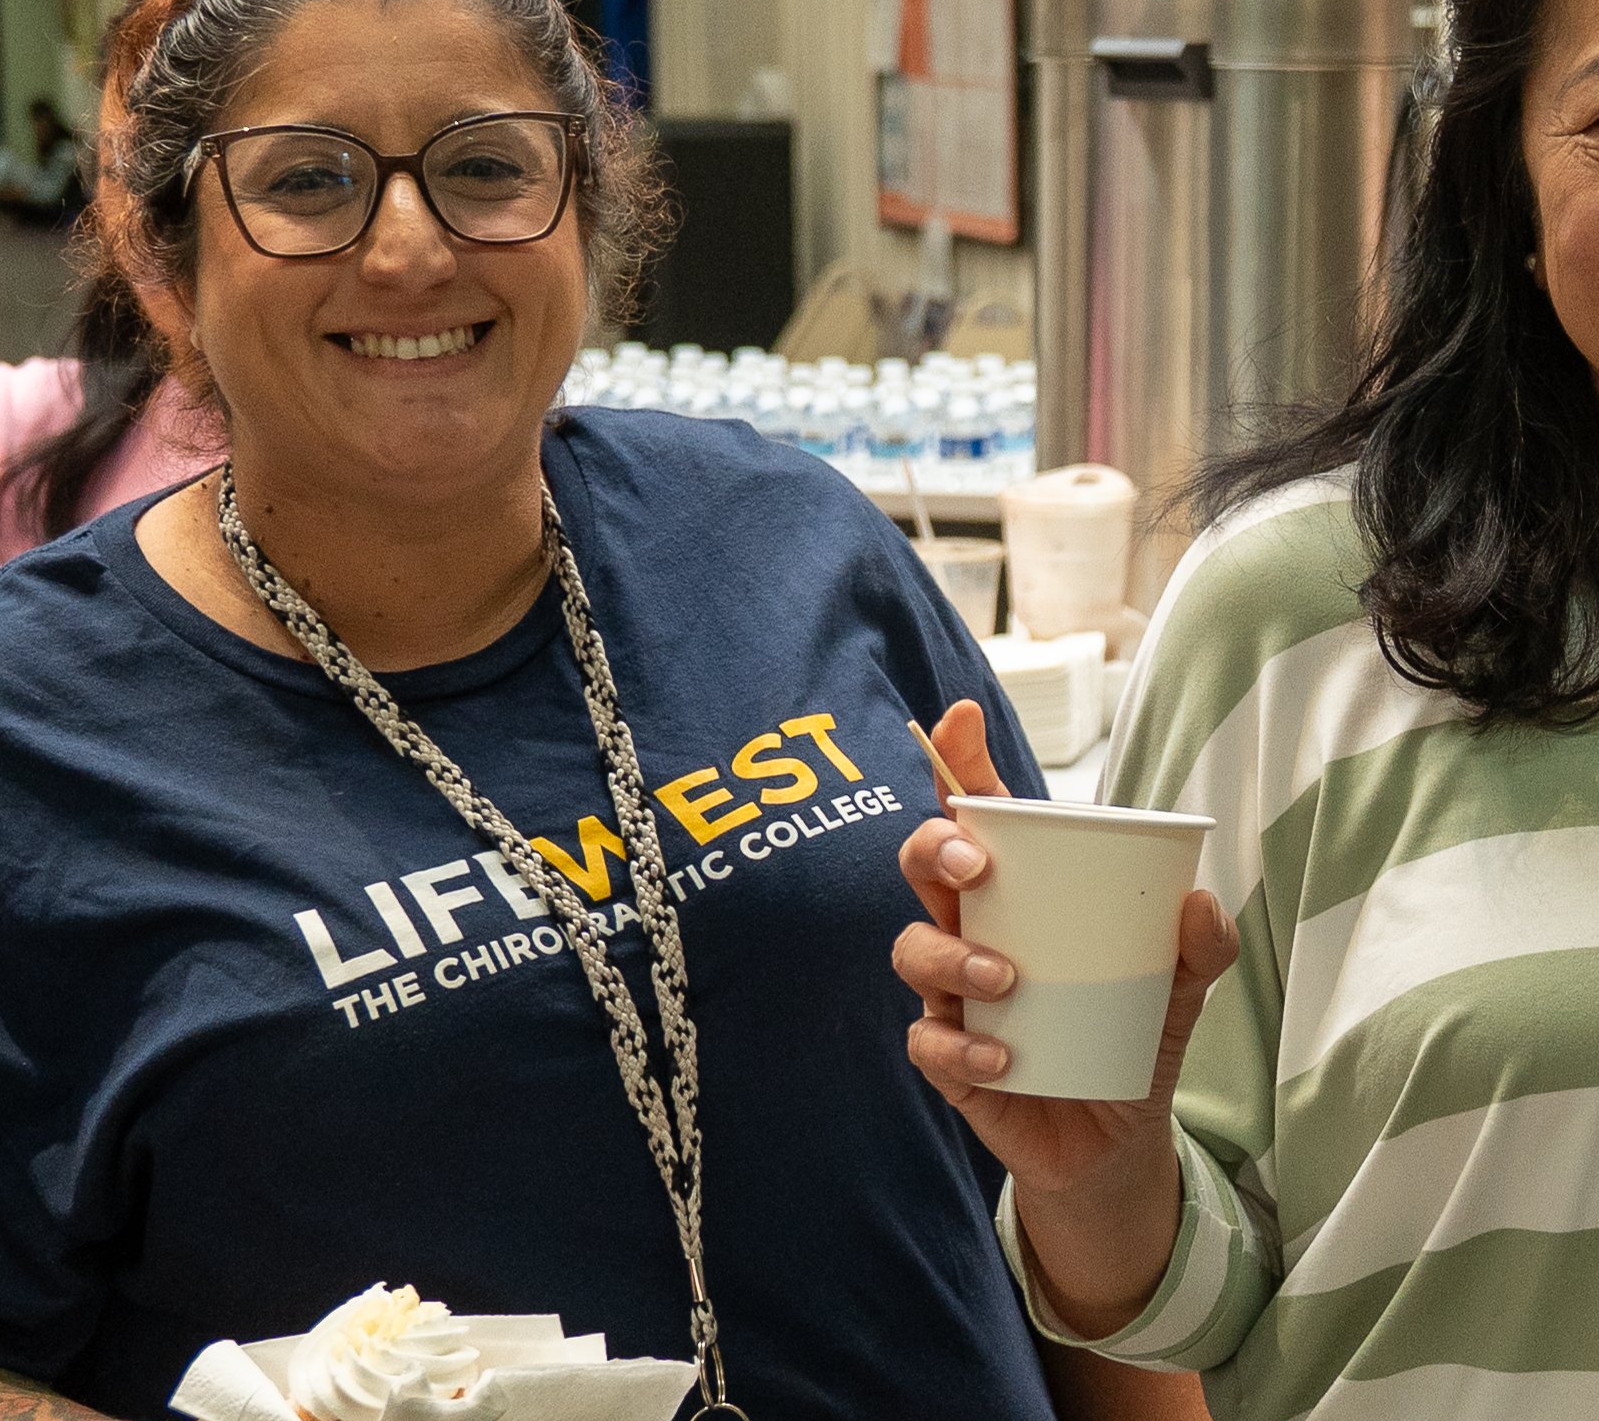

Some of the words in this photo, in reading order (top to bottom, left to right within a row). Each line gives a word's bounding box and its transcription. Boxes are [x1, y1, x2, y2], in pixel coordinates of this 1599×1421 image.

[332, 971, 427, 1030] THE
[433, 849, 734, 990] CHIRORATIC
[739, 785, 903, 861] COLLEGE
